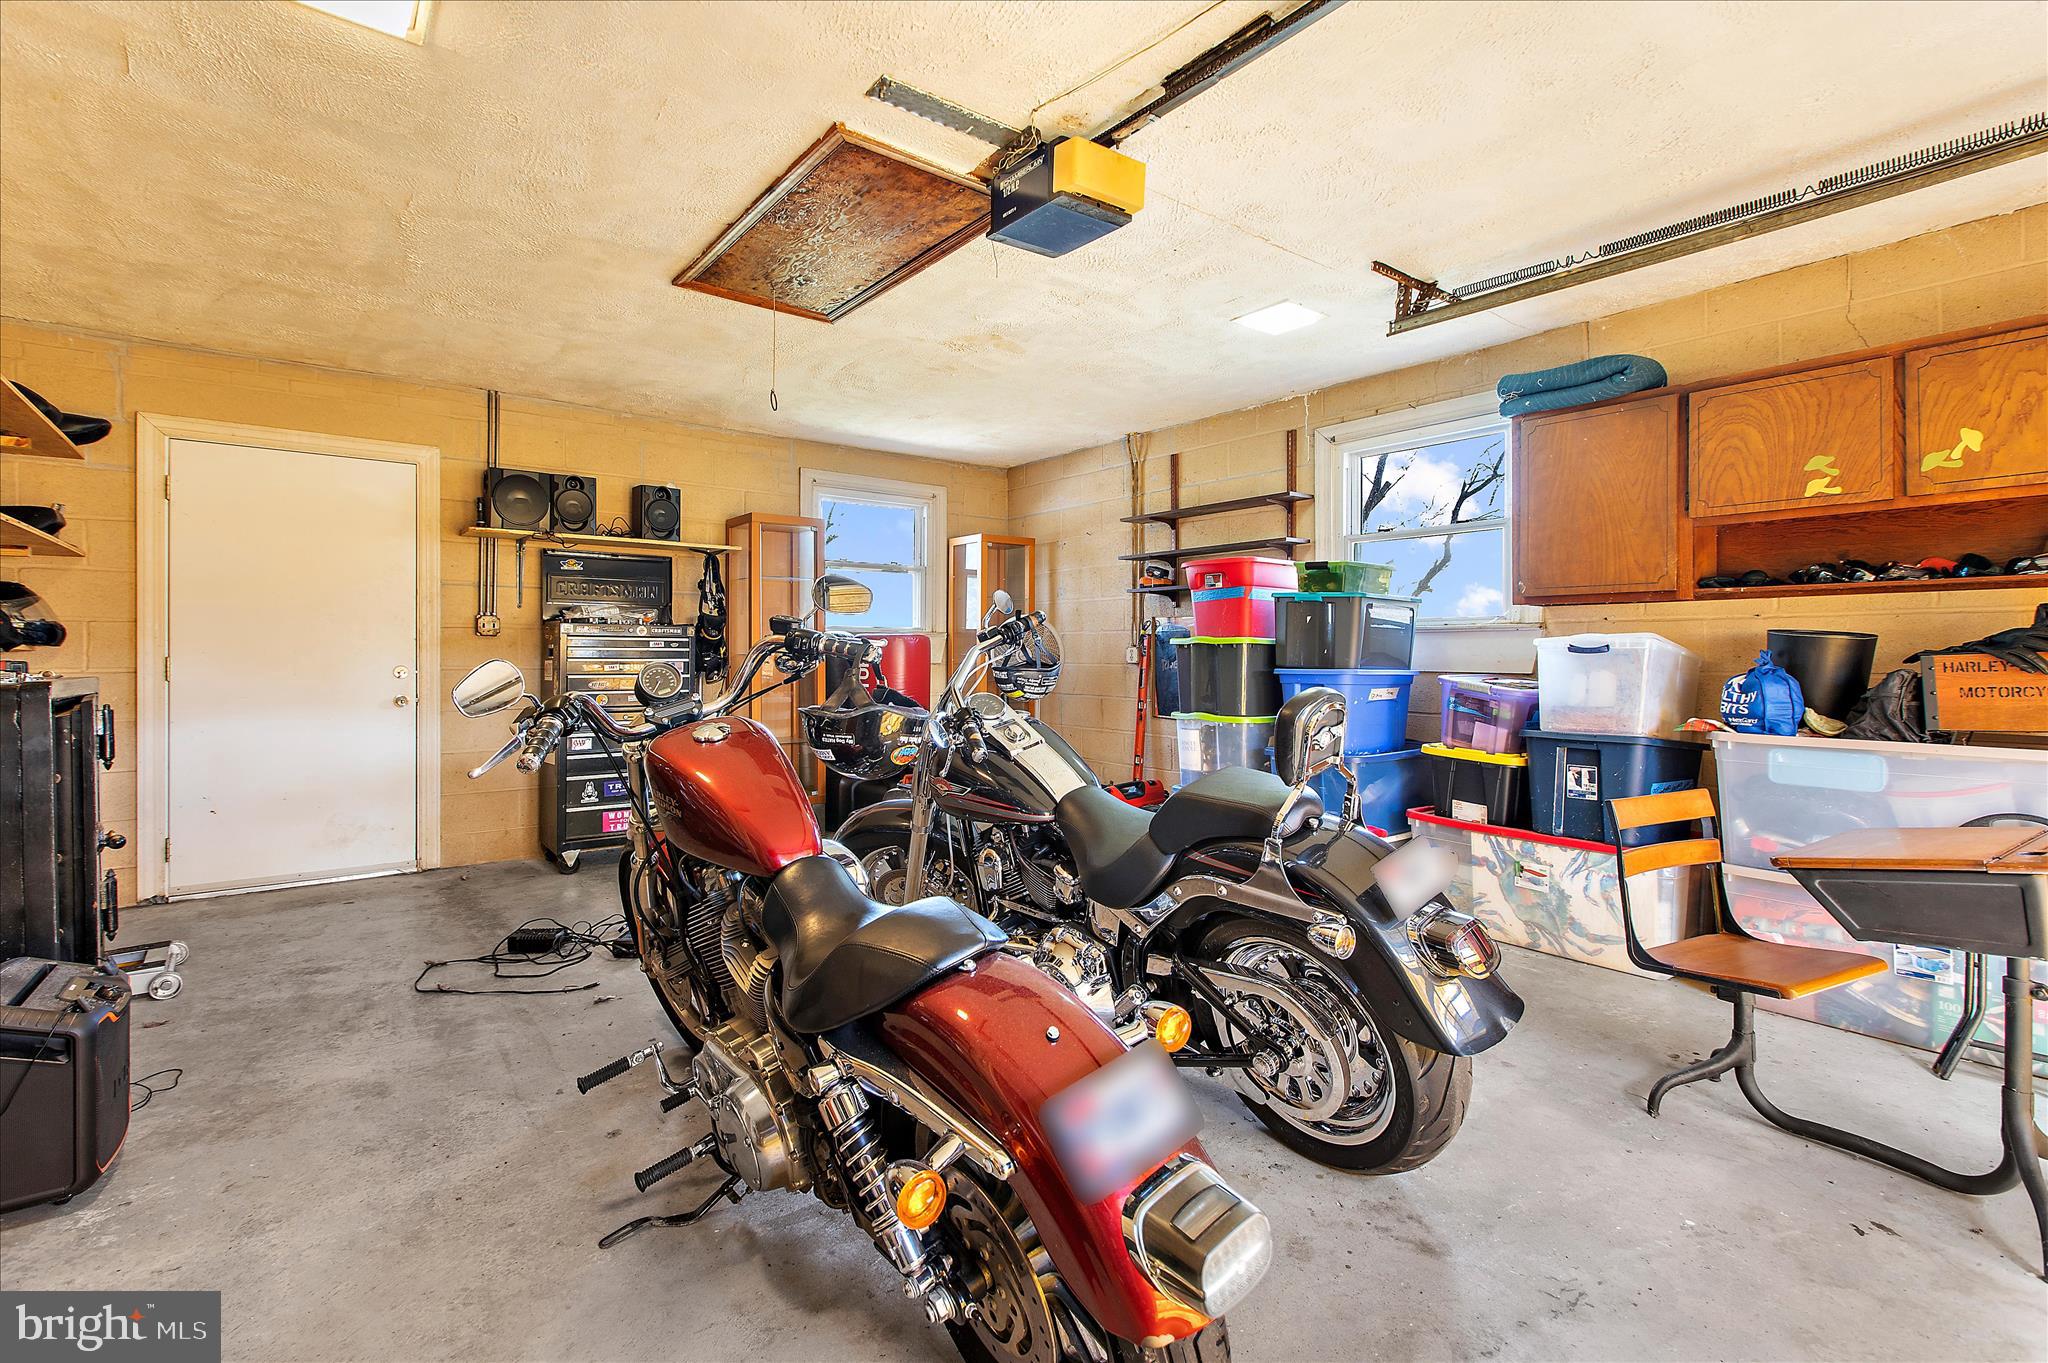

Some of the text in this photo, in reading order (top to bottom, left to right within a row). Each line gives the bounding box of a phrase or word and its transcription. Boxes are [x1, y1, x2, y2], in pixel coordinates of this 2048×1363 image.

[556, 581, 659, 599] CRAFTSMAN
[1960, 686, 2048, 698] MOTORCY
[1720, 702, 1749, 714] BITS
[1939, 1001, 1961, 1012] 100
